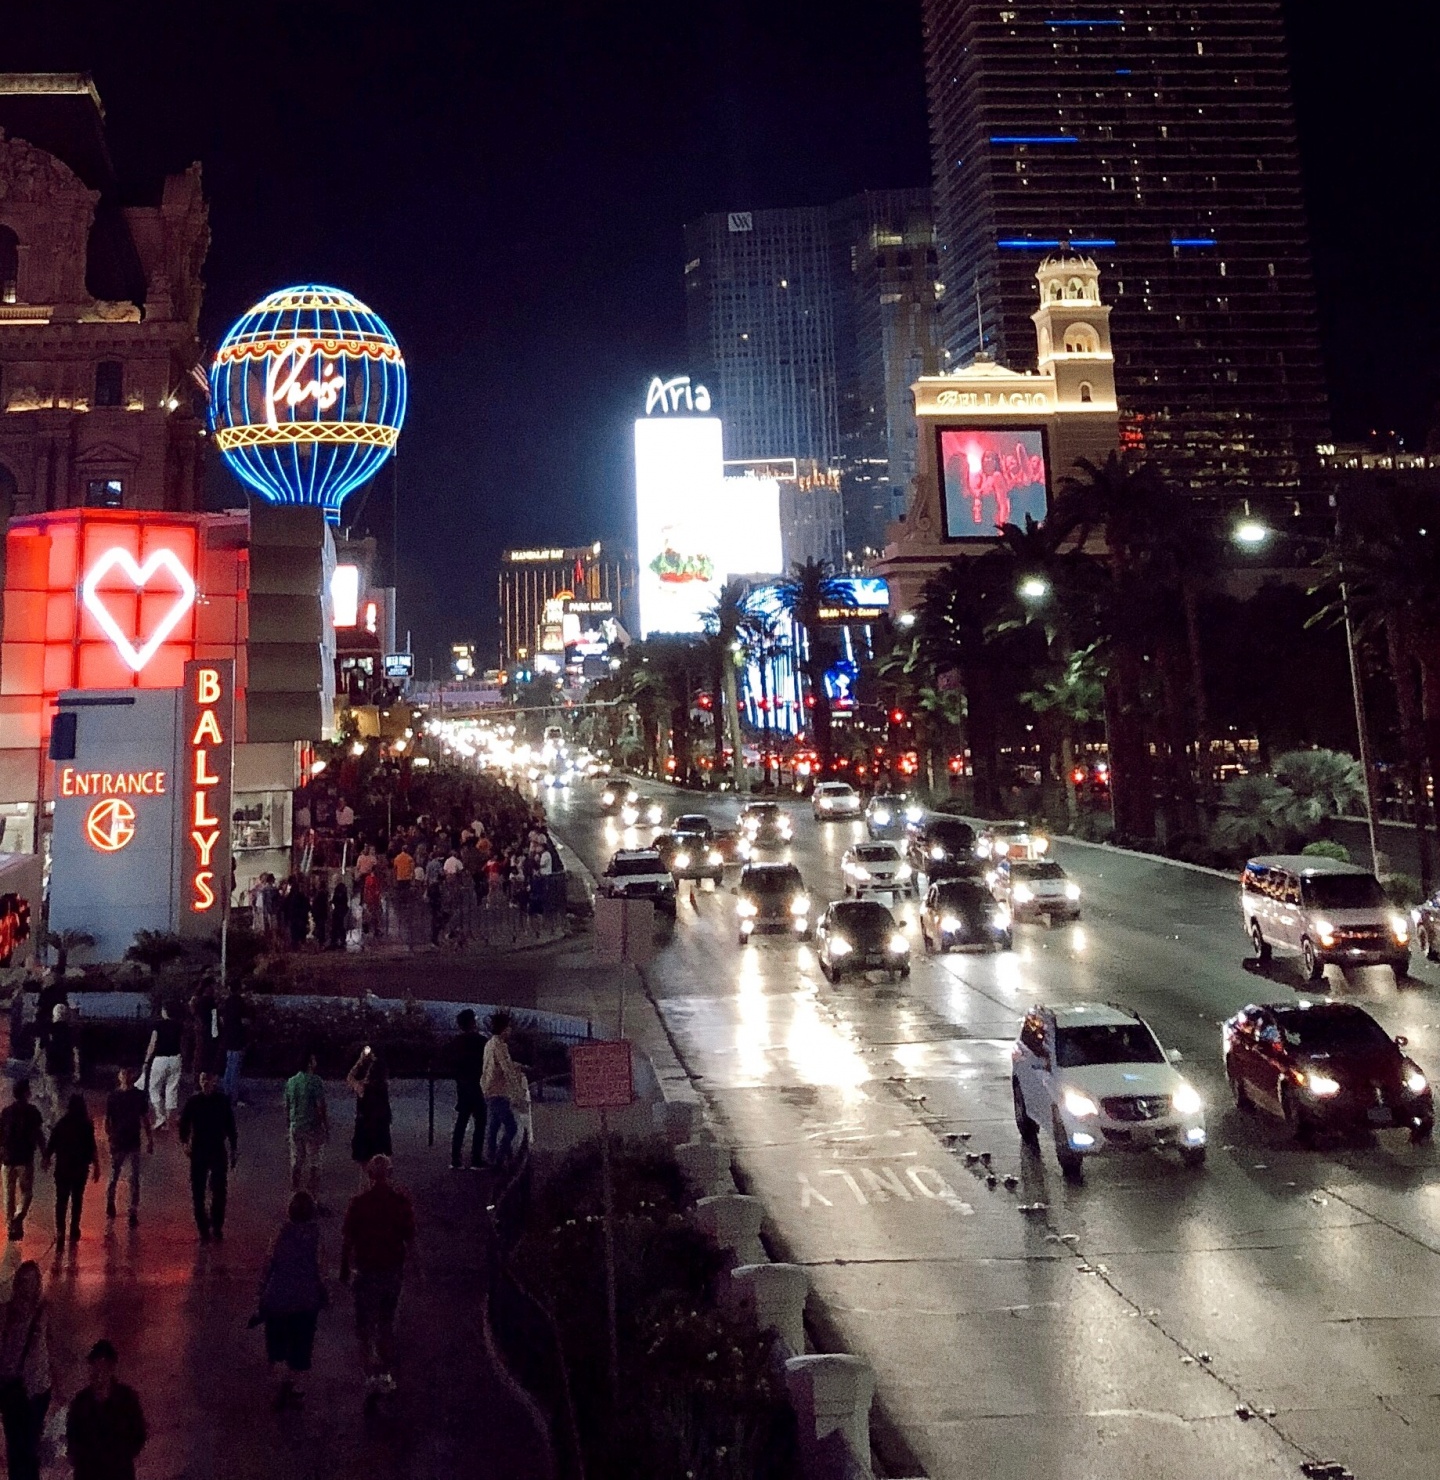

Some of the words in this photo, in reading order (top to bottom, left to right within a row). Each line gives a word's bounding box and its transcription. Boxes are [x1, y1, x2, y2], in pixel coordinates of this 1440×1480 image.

[266, 338, 344, 431] Paris
[646, 377, 710, 414] Aria
[937, 391, 1048, 407] BELLAGIO
[569, 602, 590, 612] PARK
[591, 601, 613, 612] MGM
[62, 768, 166, 796] ENTRANCE
[193, 669, 223, 909] BALLYS
[797, 1165, 976, 1216] ONLY
